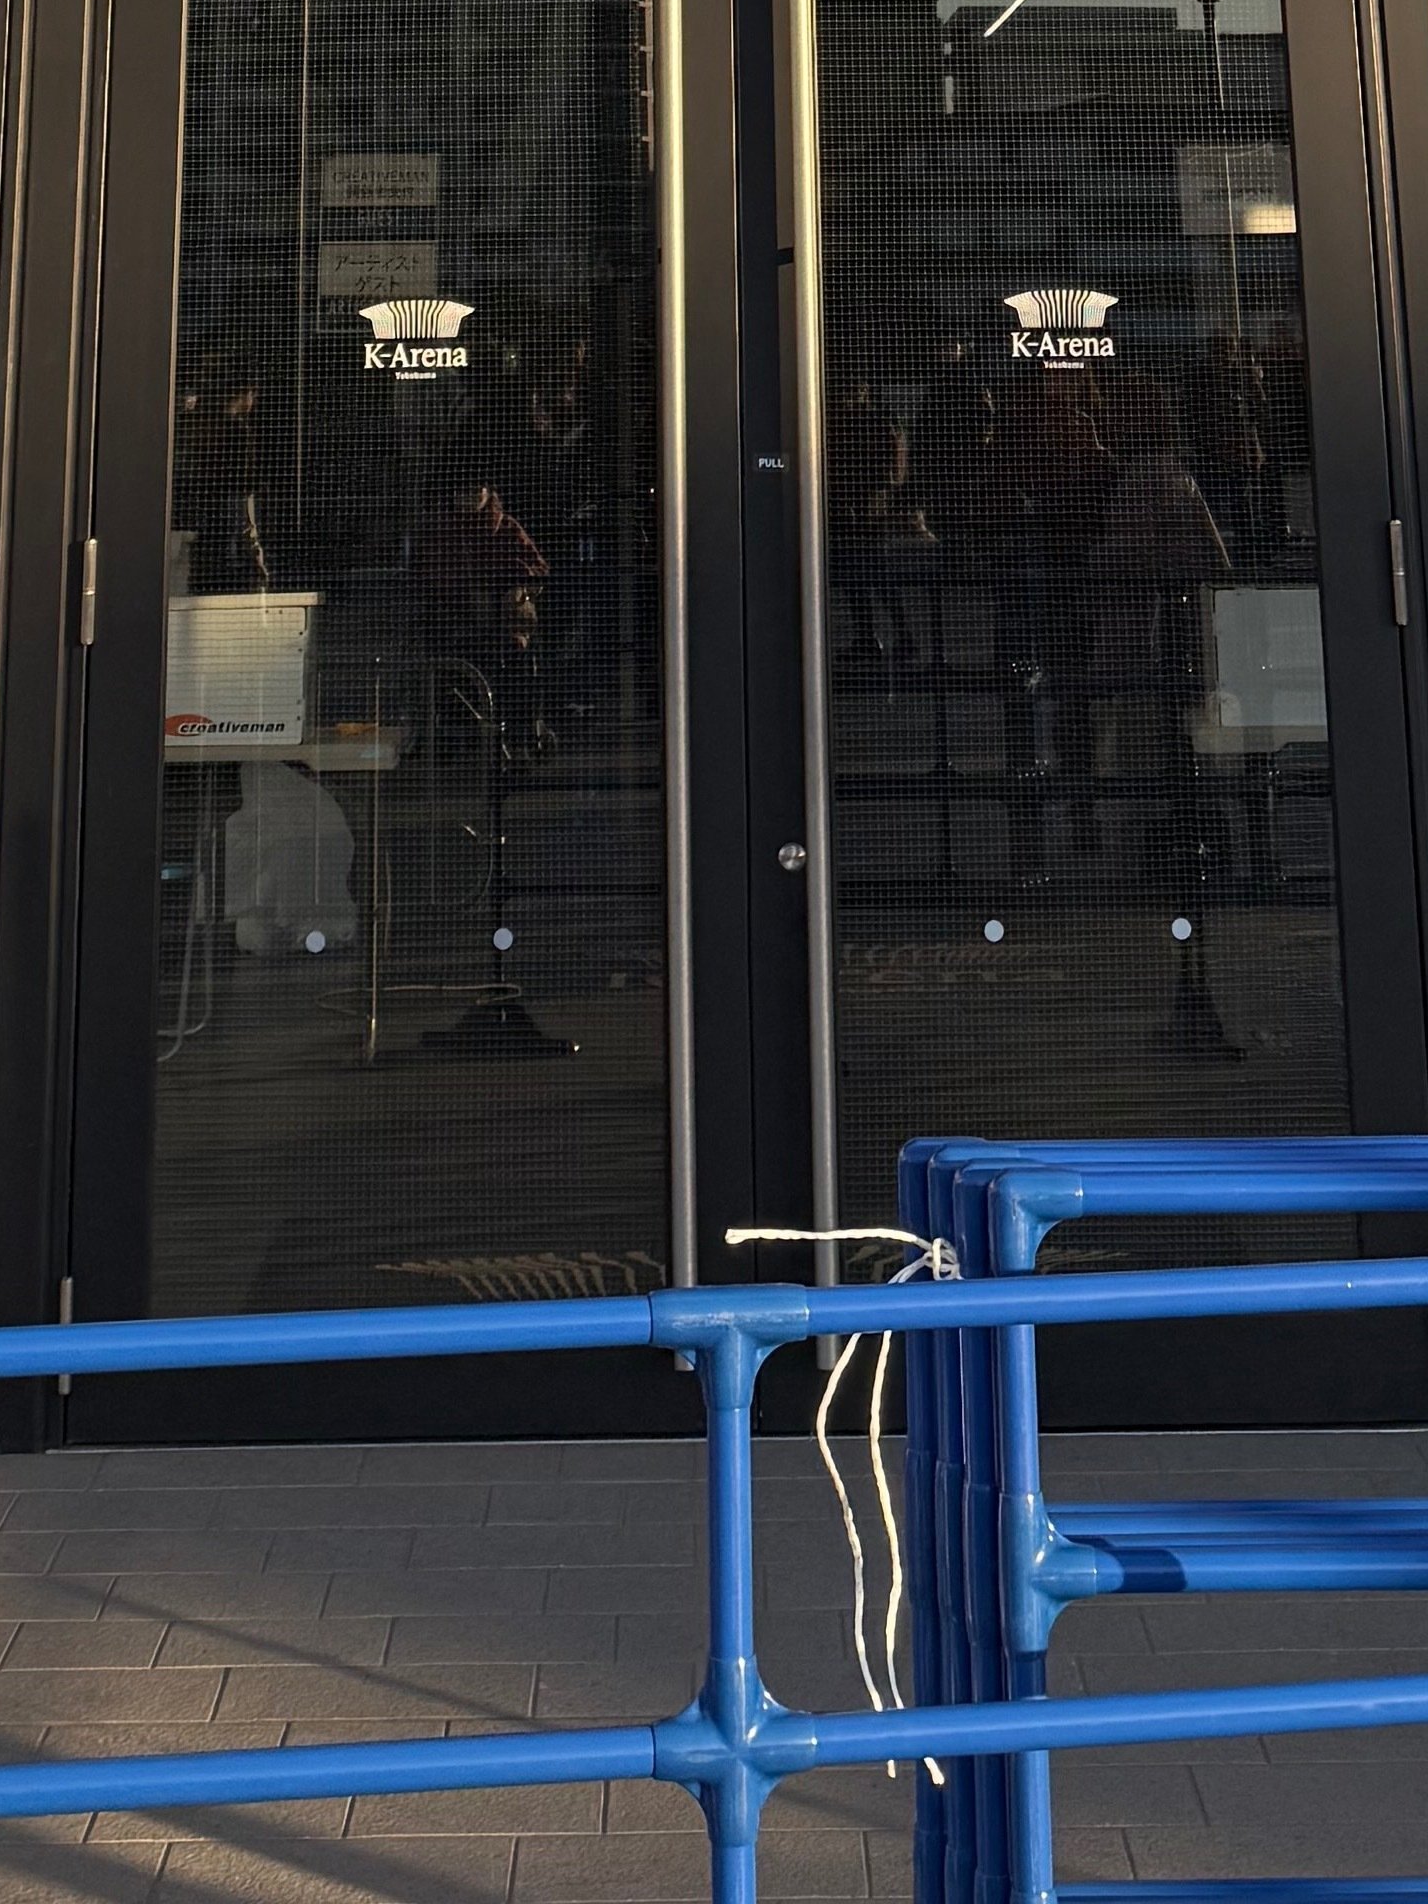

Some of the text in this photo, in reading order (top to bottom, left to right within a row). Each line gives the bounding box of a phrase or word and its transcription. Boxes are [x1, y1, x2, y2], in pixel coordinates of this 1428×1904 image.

[1011, 331, 1116, 358] K-Arena
[363, 342, 468, 369] K-Arena
[758, 457, 785, 469] PULL
[178, 720, 286, 735] creativeman
